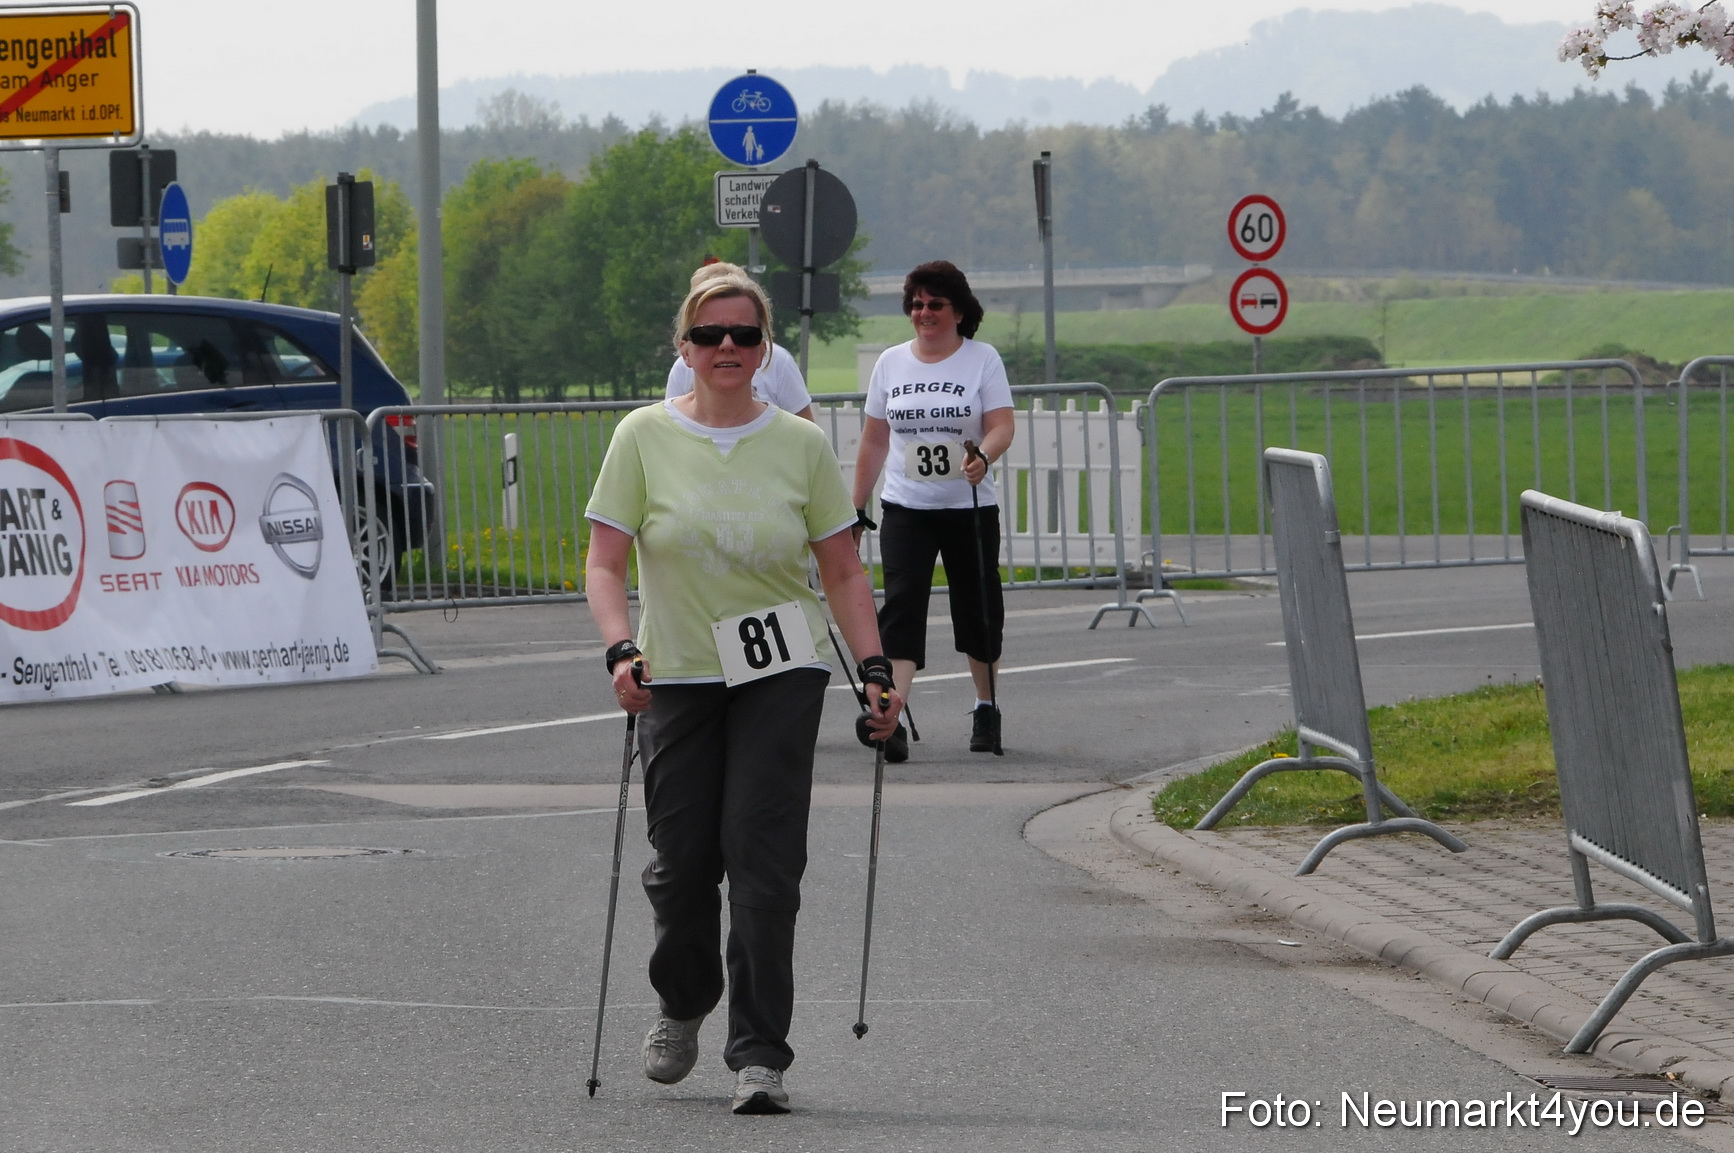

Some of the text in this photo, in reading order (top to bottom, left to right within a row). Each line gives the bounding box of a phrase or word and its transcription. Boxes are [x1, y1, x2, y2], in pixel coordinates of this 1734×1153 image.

[1, 70, 99, 92] am Anger
[16, 106, 75, 122] Neumarkt
[82, 104, 123, 120] i.d.OPf.
[1241, 213, 1273, 243] 60
[892, 382, 965, 398] BERGER
[930, 405, 972, 418] GIRLS
[936, 426, 963, 436] talking
[916, 444, 951, 477] 33
[51, 498, 62, 521] &
[185, 500, 226, 536] KIA
[100, 572, 163, 592] SEAT
[175, 563, 260, 587] KIA MOTORS
[738, 611, 792, 670] 81
[13, 652, 93, 691] Sengenthal
[219, 636, 350, 676] www.gerhart-jaenig.de
